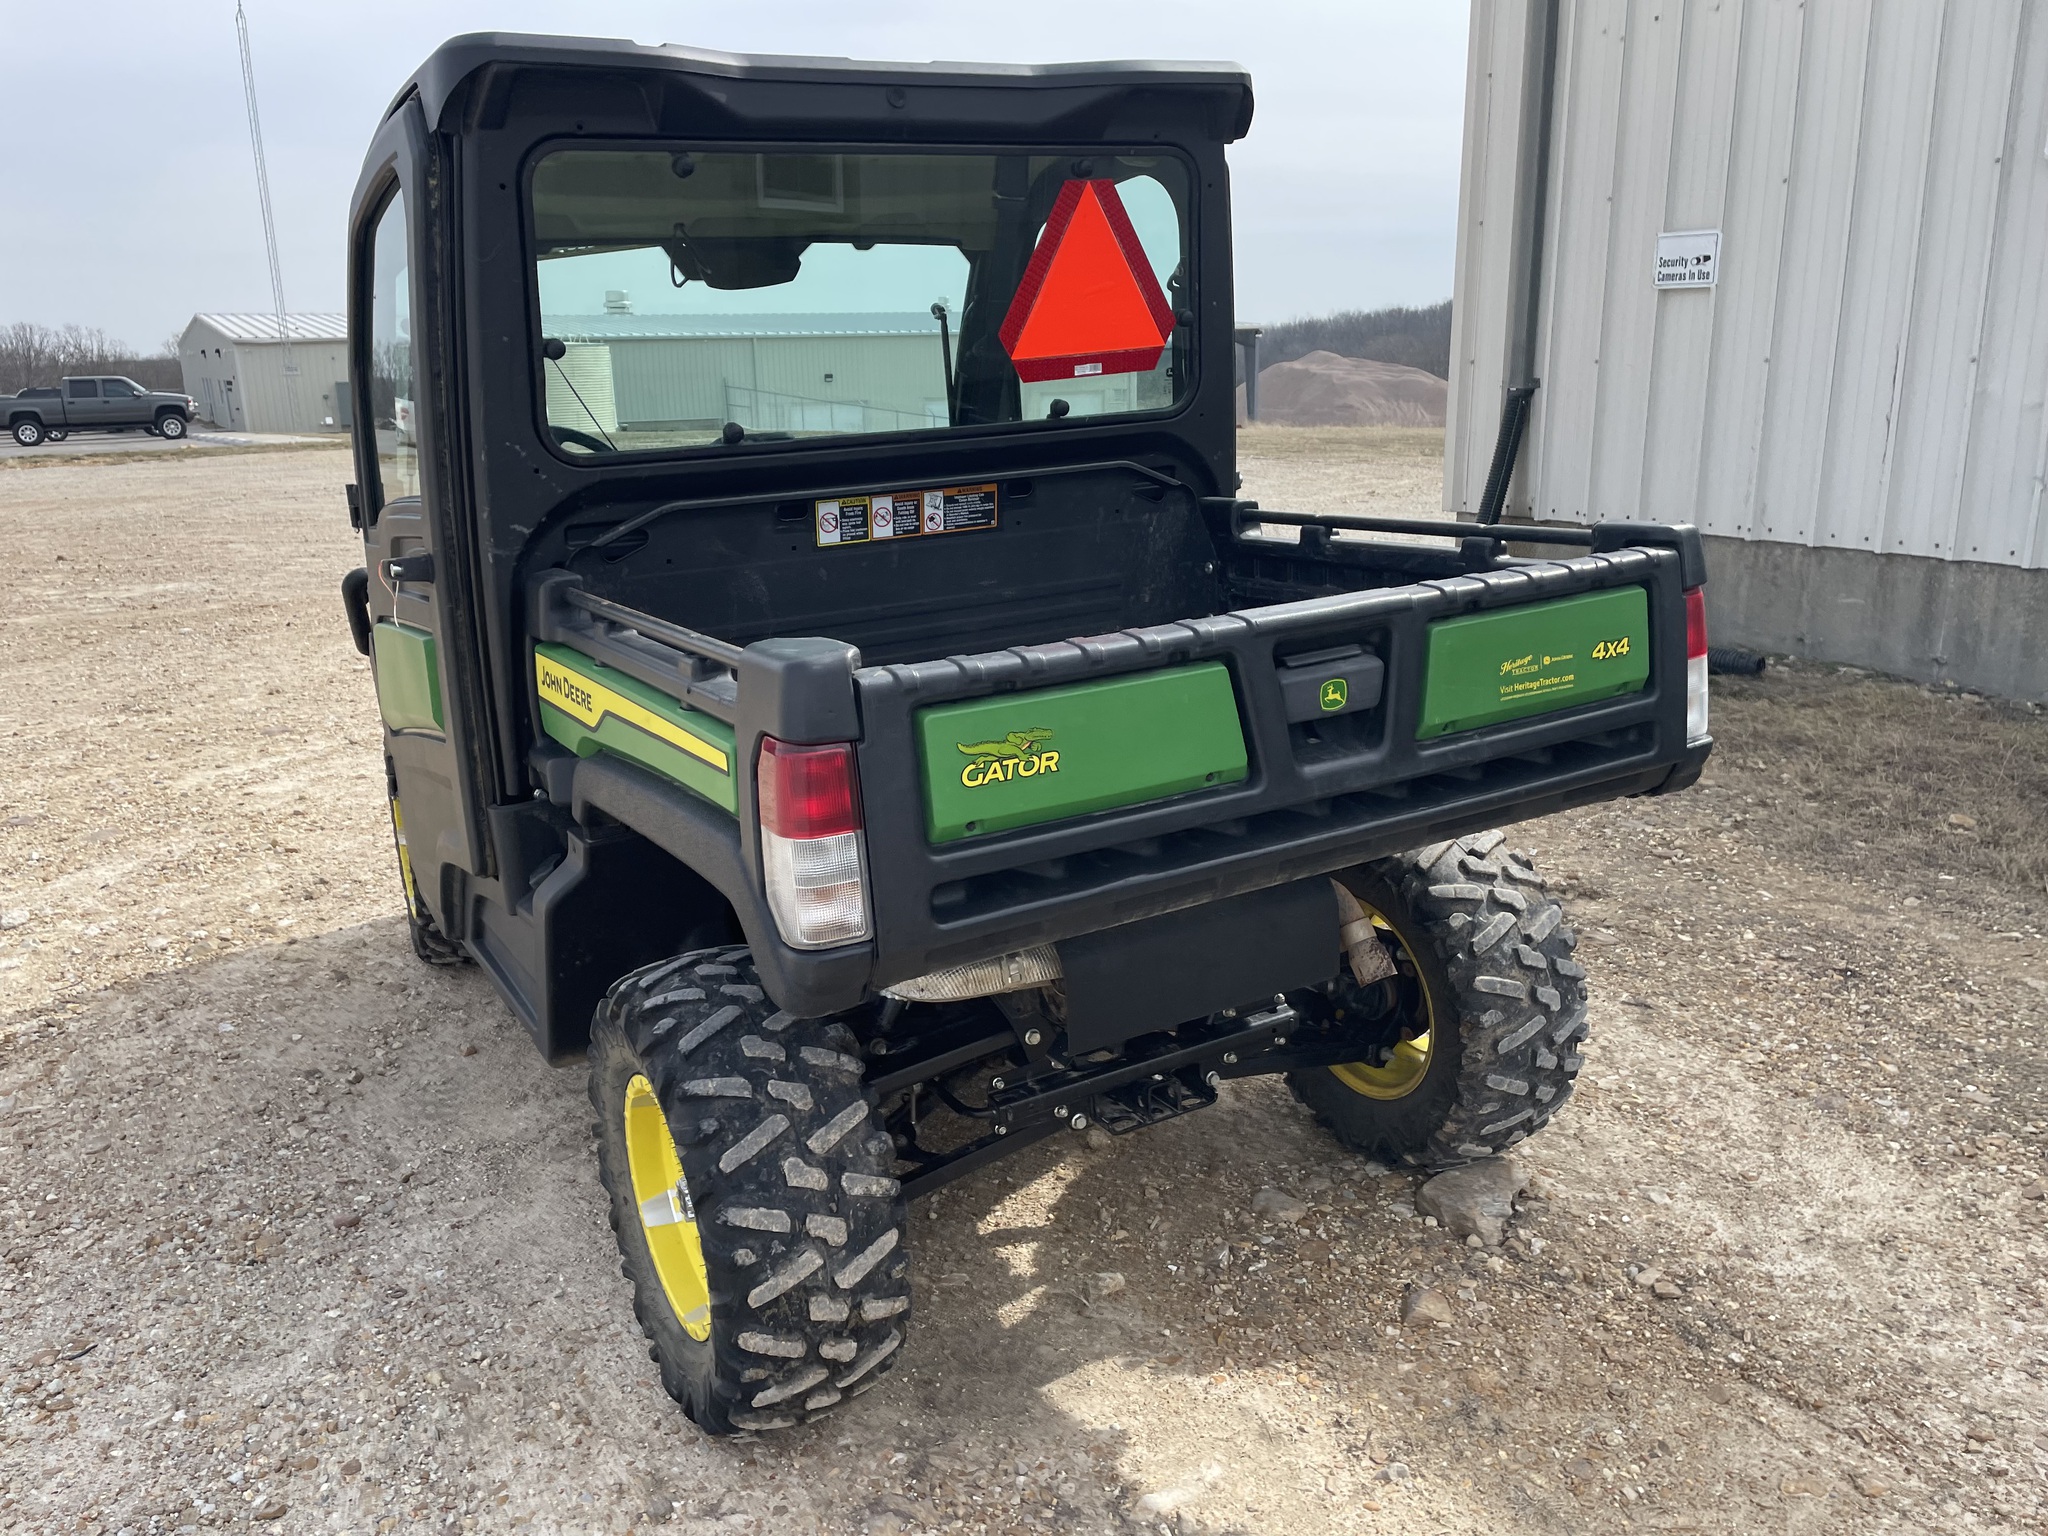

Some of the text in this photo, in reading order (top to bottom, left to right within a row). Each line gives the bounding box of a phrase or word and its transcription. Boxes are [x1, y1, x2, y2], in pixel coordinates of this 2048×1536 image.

[1658, 256, 1689, 269] Security
[1657, 269, 1711, 282] Cameras In Use
[1499, 654, 1533, 676] Heritage
[541, 666, 593, 713] JOHN DEERE
[1500, 685, 1514, 694] Visit
[1514, 674, 1575, 691] HeritageTractor.com
[960, 750, 1061, 788] GATOR
